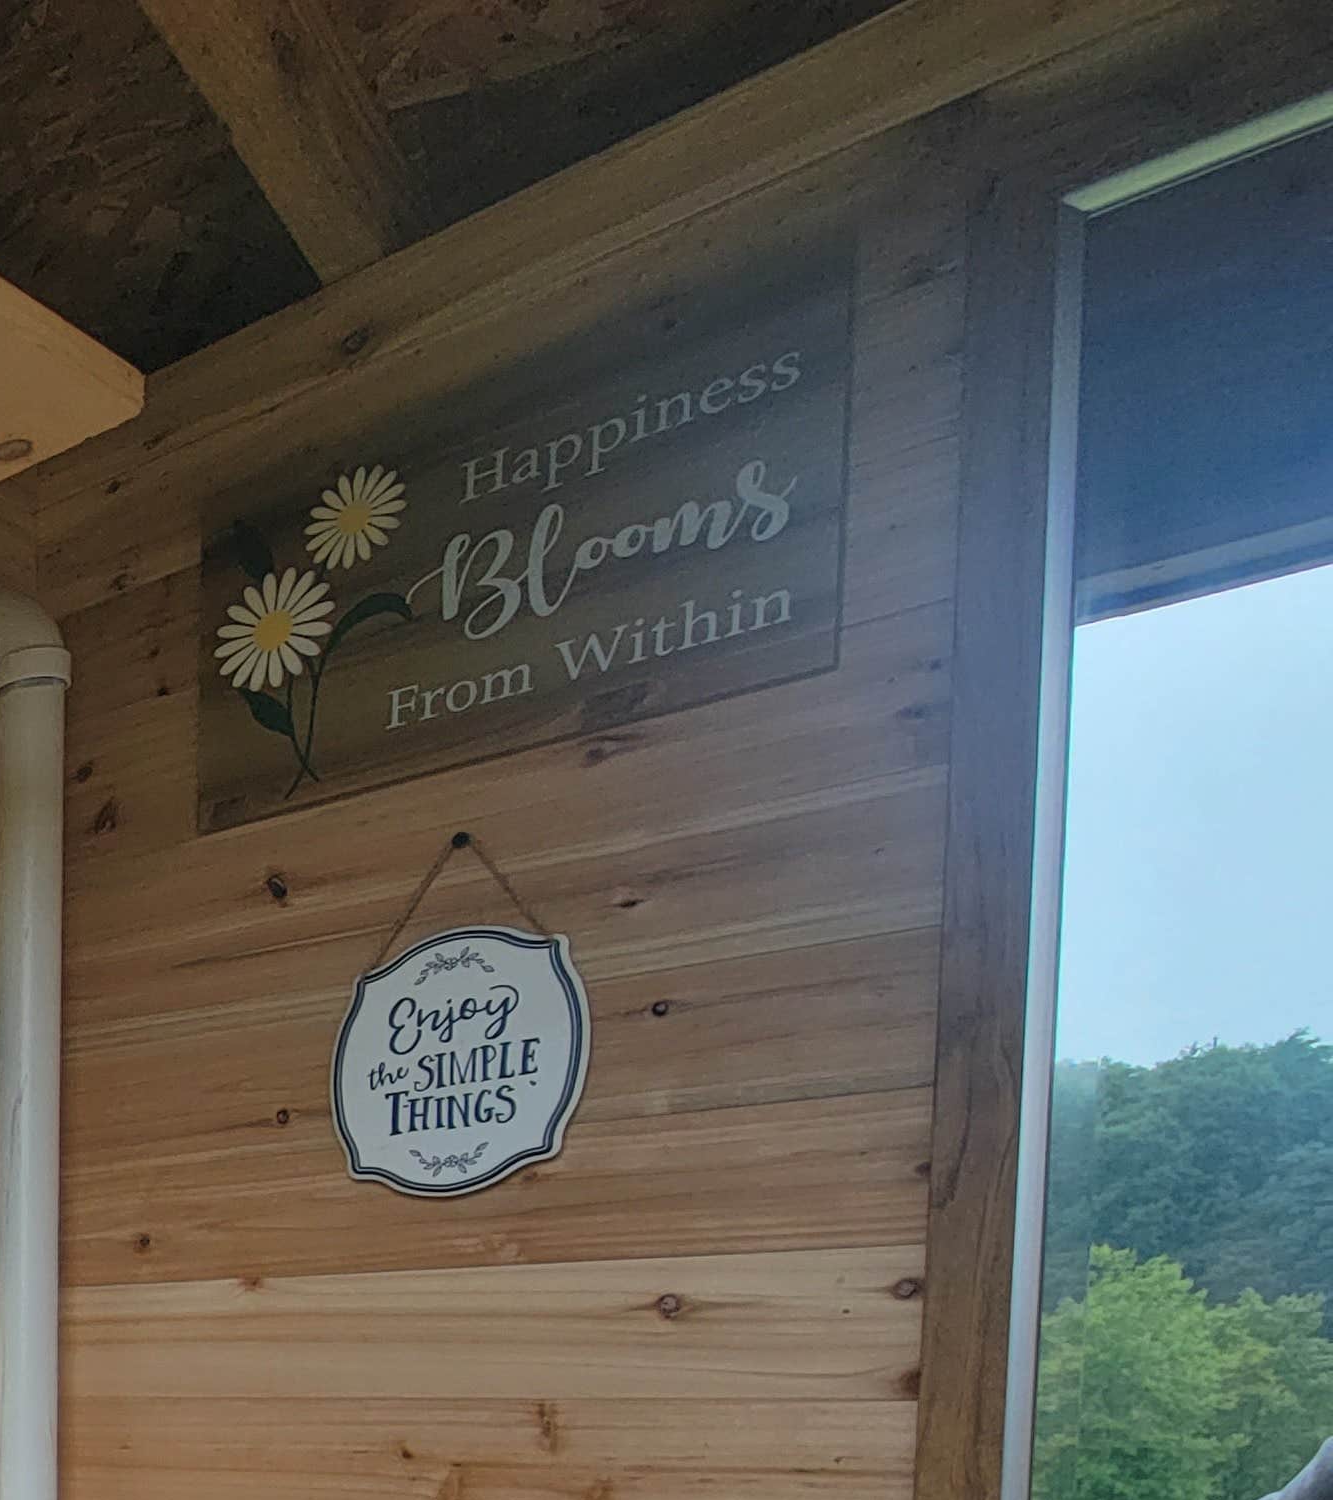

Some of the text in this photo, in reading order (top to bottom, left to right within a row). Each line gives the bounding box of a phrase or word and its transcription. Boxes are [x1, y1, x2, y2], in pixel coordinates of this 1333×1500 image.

[458, 350, 803, 503] Happiness
[406, 459, 799, 641] Blooms
[384, 587, 792, 730] From Within
[366, 1038, 541, 1092] the SIMPLE
[388, 984, 520, 1055] Enjoy
[385, 1084, 517, 1136] THINGS
